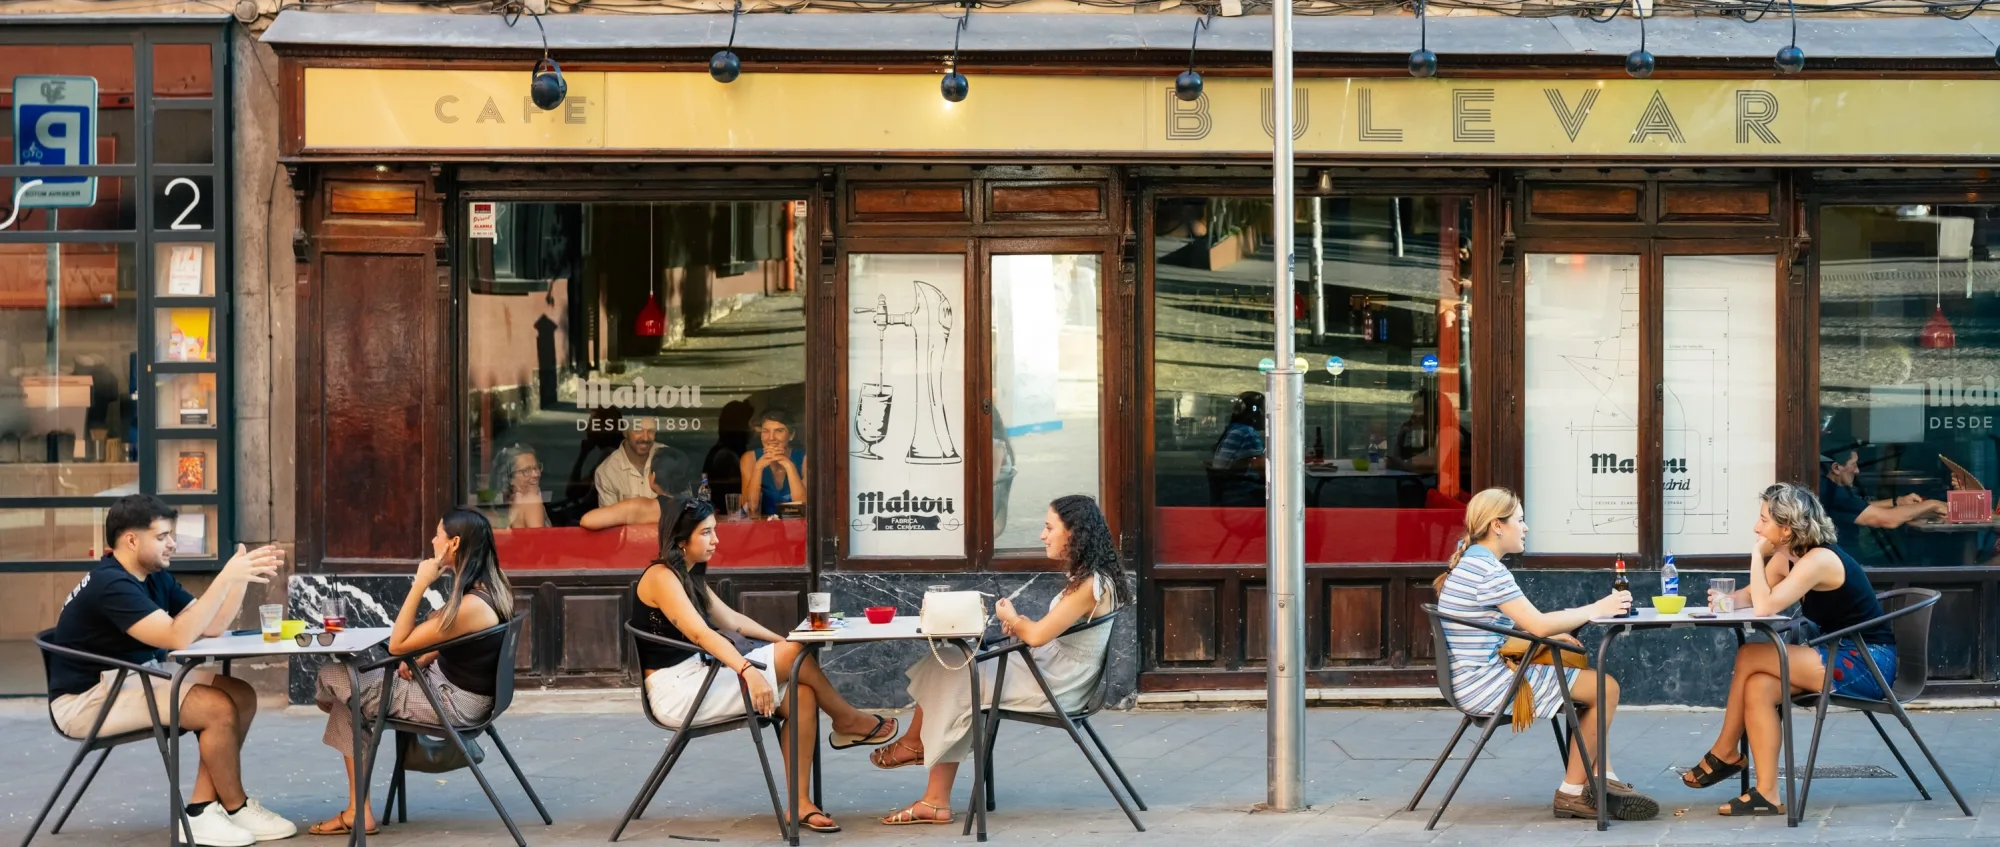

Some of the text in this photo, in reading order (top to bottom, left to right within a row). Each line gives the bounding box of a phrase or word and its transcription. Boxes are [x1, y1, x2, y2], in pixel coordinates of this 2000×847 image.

[435, 95, 586, 124] CAFE
[1166, 87, 1781, 143] BULEVAR
[165, 177, 202, 230] 2
[576, 376, 703, 409] Mahou
[577, 418, 701, 432] DESDE 1890
[1930, 416, 1993, 429] DESDE
[1590, 453, 1688, 473] Mau
[1662, 478, 1690, 490] adrid
[857, 489, 955, 515] Mahou
